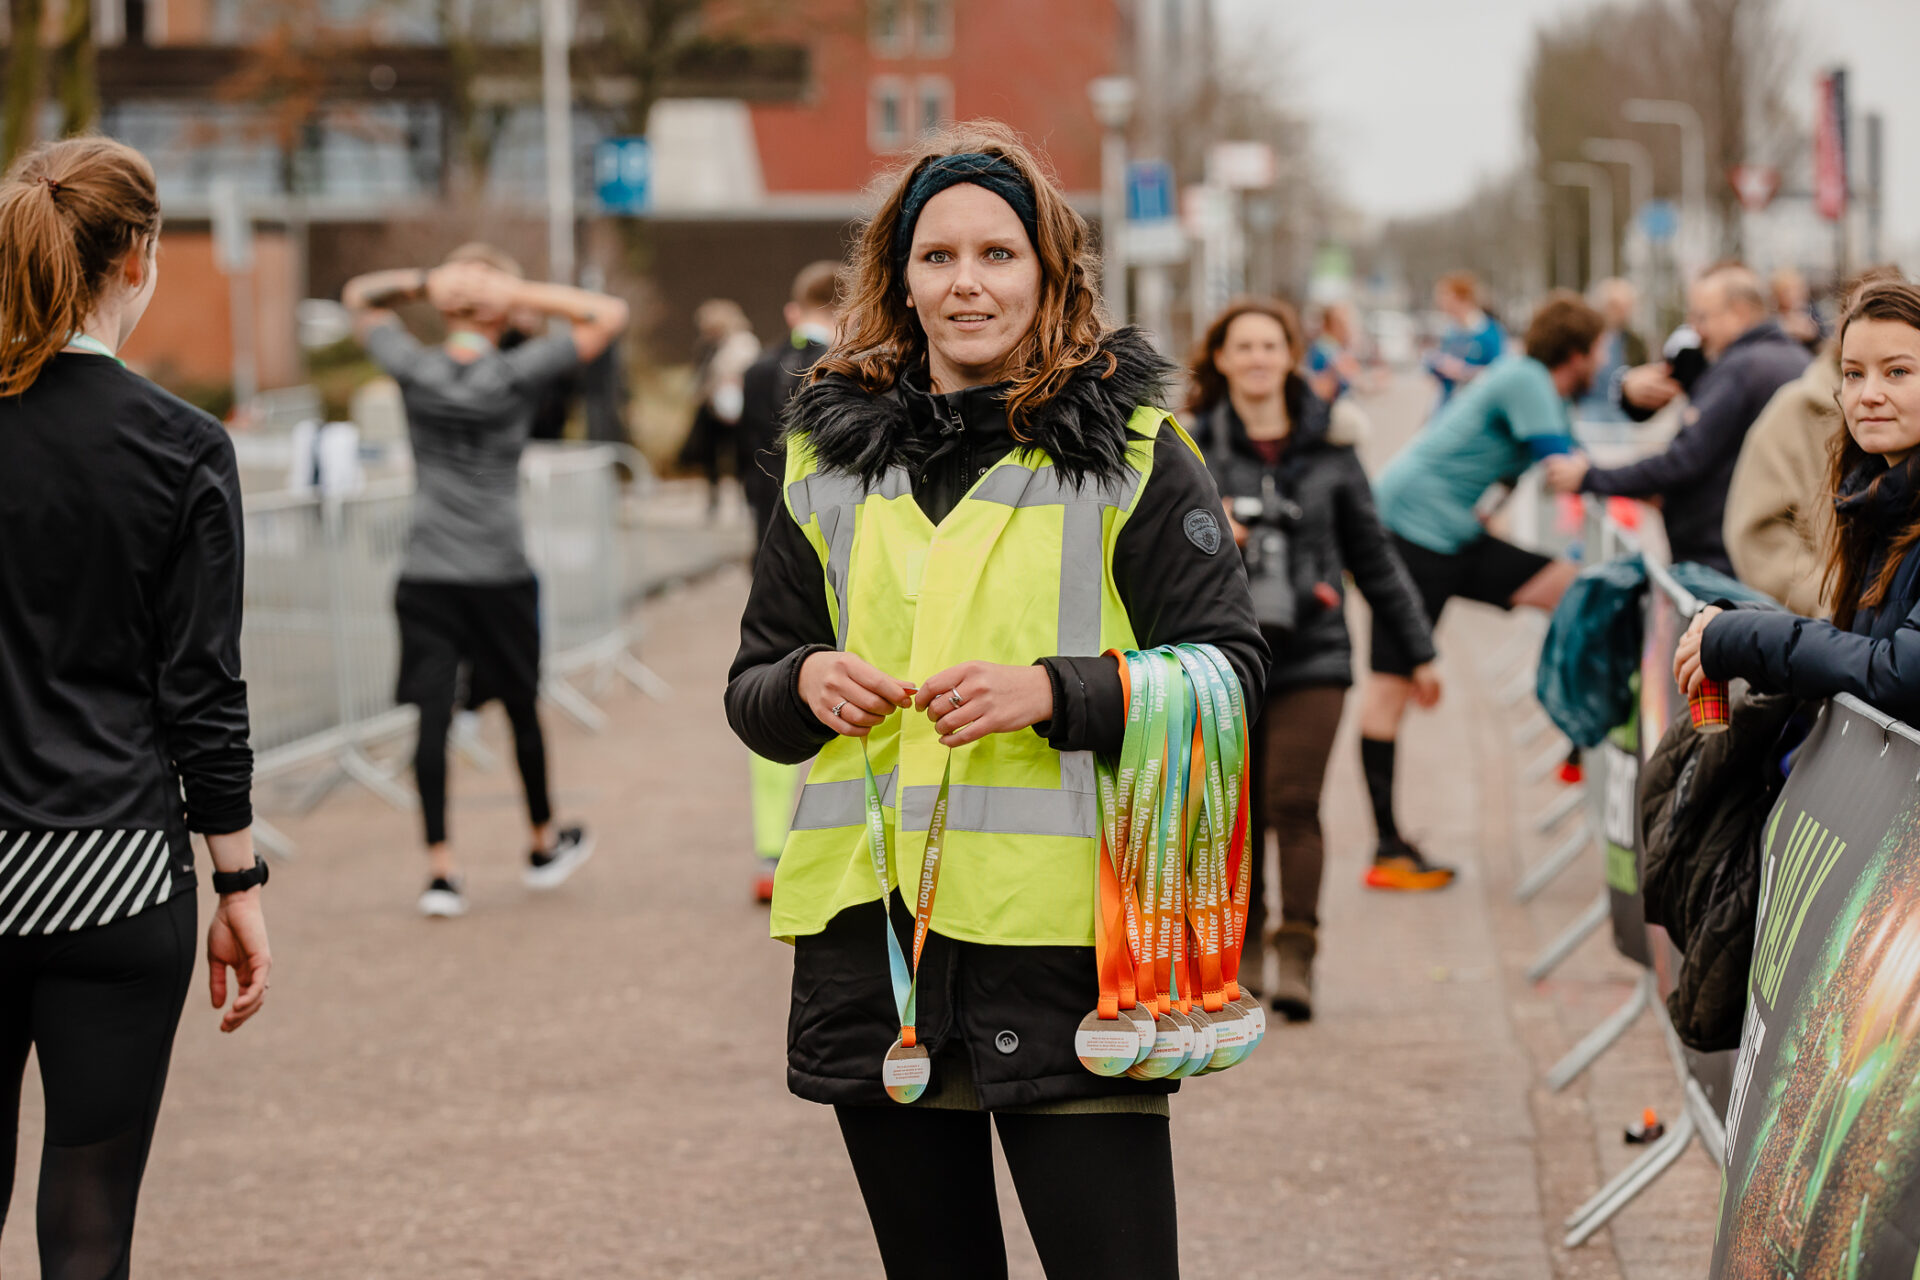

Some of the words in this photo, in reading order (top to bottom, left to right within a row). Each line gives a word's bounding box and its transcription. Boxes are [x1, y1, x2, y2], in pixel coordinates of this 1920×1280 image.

[1216, 688, 1232, 732] Winter
[1118, 768, 1135, 810] Winter
[1142, 758, 1160, 801] Winter
[1209, 760, 1224, 838] Leeuwarden
[869, 795, 887, 873] Leeuwarden
[930, 799, 947, 840] Winter
[919, 846, 940, 909] Marathon
[1144, 851, 1156, 914] Marathon
[1160, 848, 1176, 910] Marathon
[1194, 848, 1209, 909] Marathon
[1216, 841, 1230, 902] Marathon
[1233, 846, 1250, 906] Marathon
[1142, 920, 1153, 964] Winter
[1156, 916, 1172, 960] Winter
[1206, 912, 1219, 956] Winter
[1223, 907, 1234, 949] Winter
